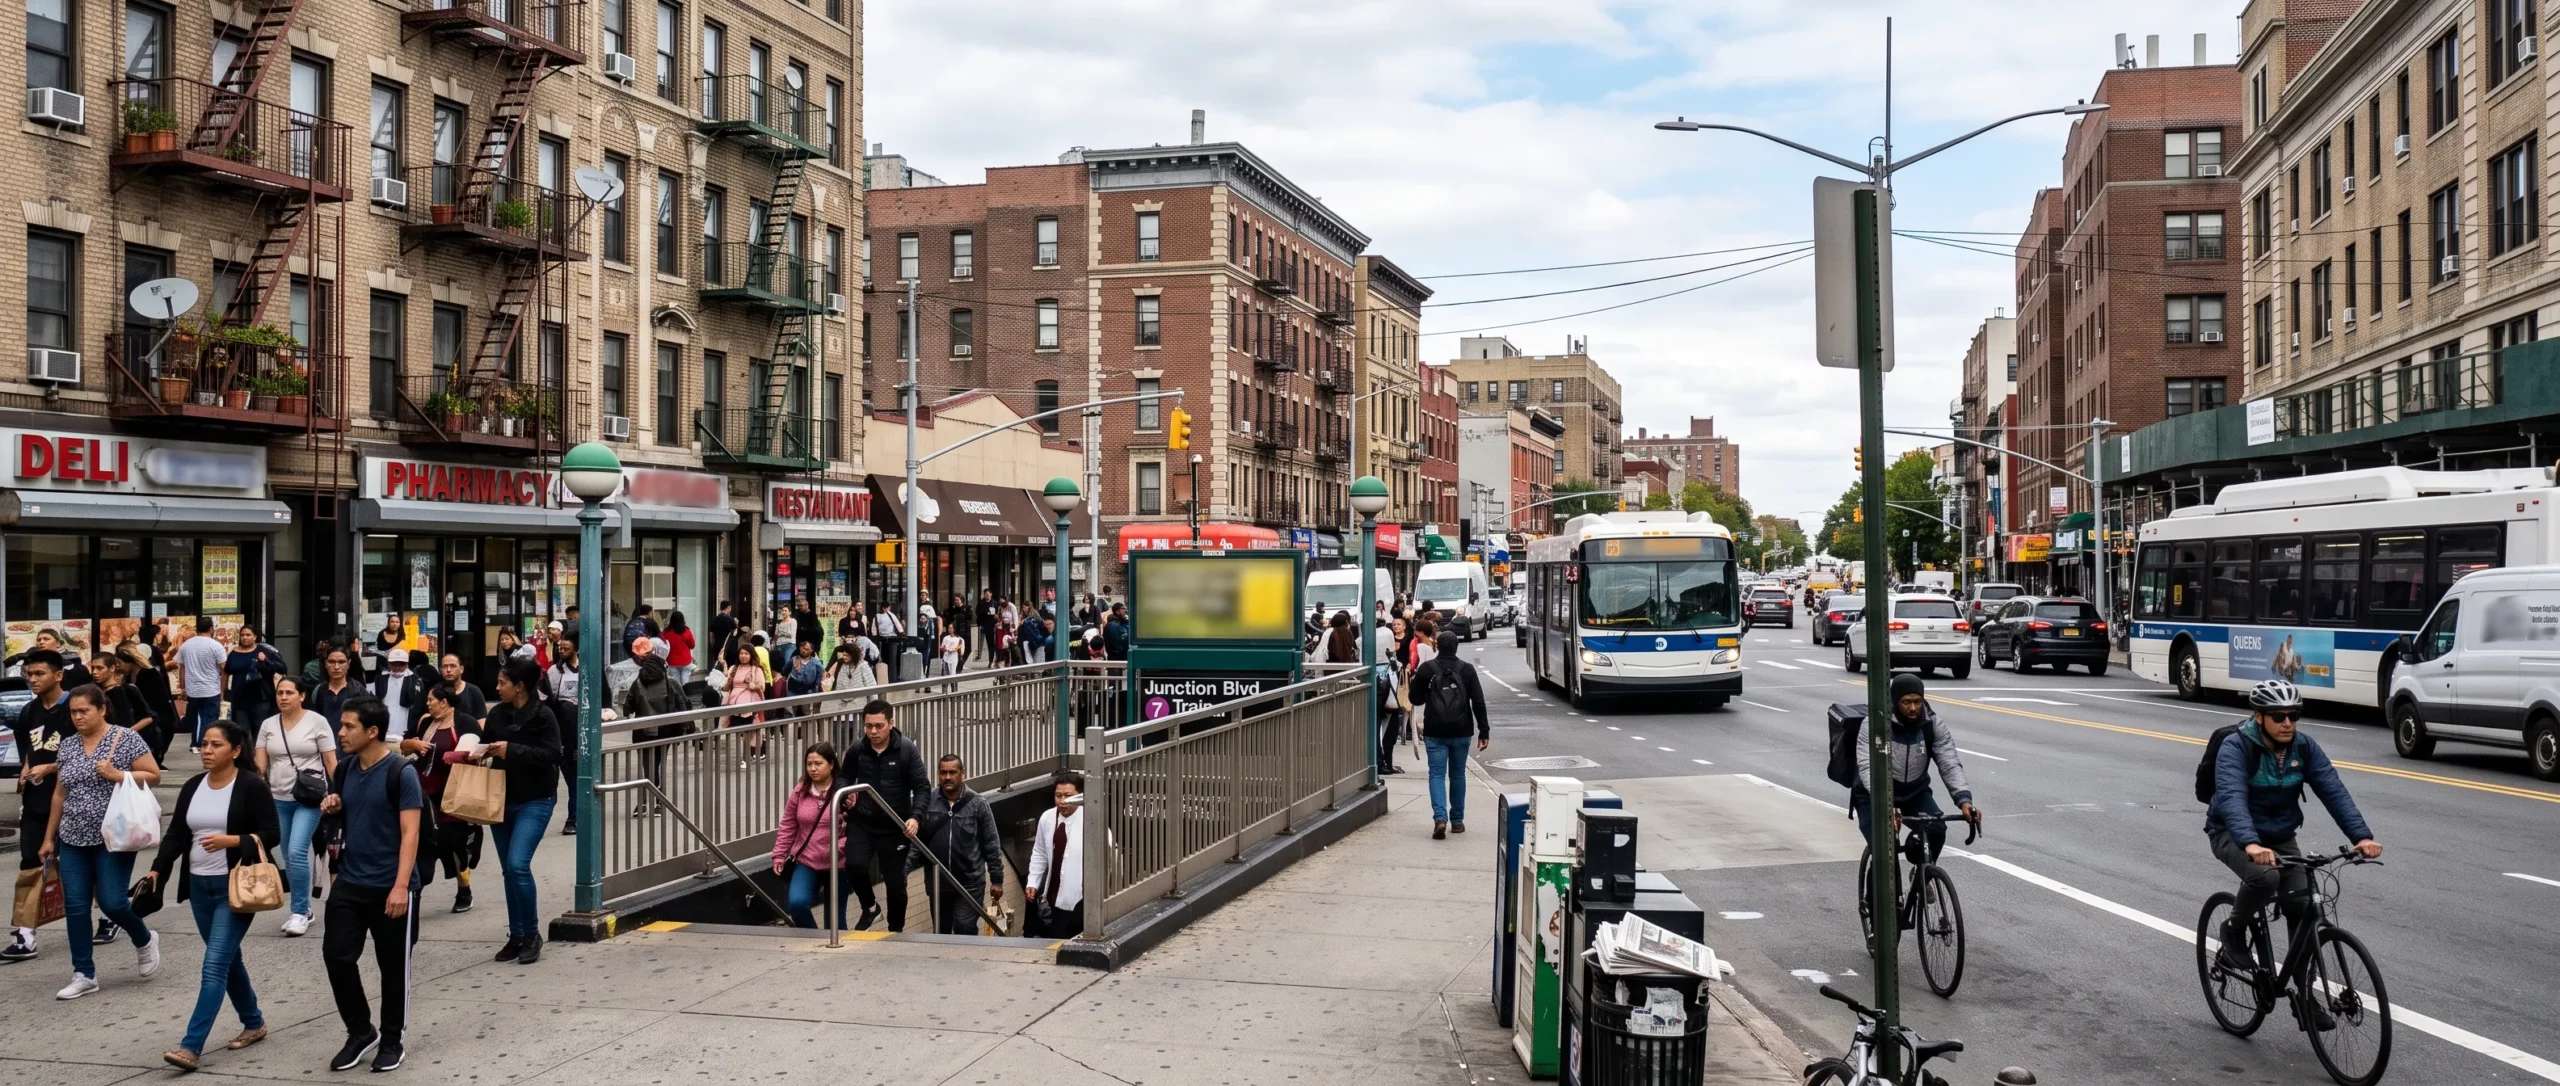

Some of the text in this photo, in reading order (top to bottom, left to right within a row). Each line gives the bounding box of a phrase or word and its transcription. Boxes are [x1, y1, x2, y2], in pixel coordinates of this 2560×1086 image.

[14, 433, 129, 482] DELI
[381, 461, 553, 505] PHARMACY
[774, 487, 873, 521] RESTAURANT
[2233, 635, 2262, 651] QUEENS
[1144, 680, 1260, 696] Junction Blvd
[1151, 701, 1163, 718] 7
